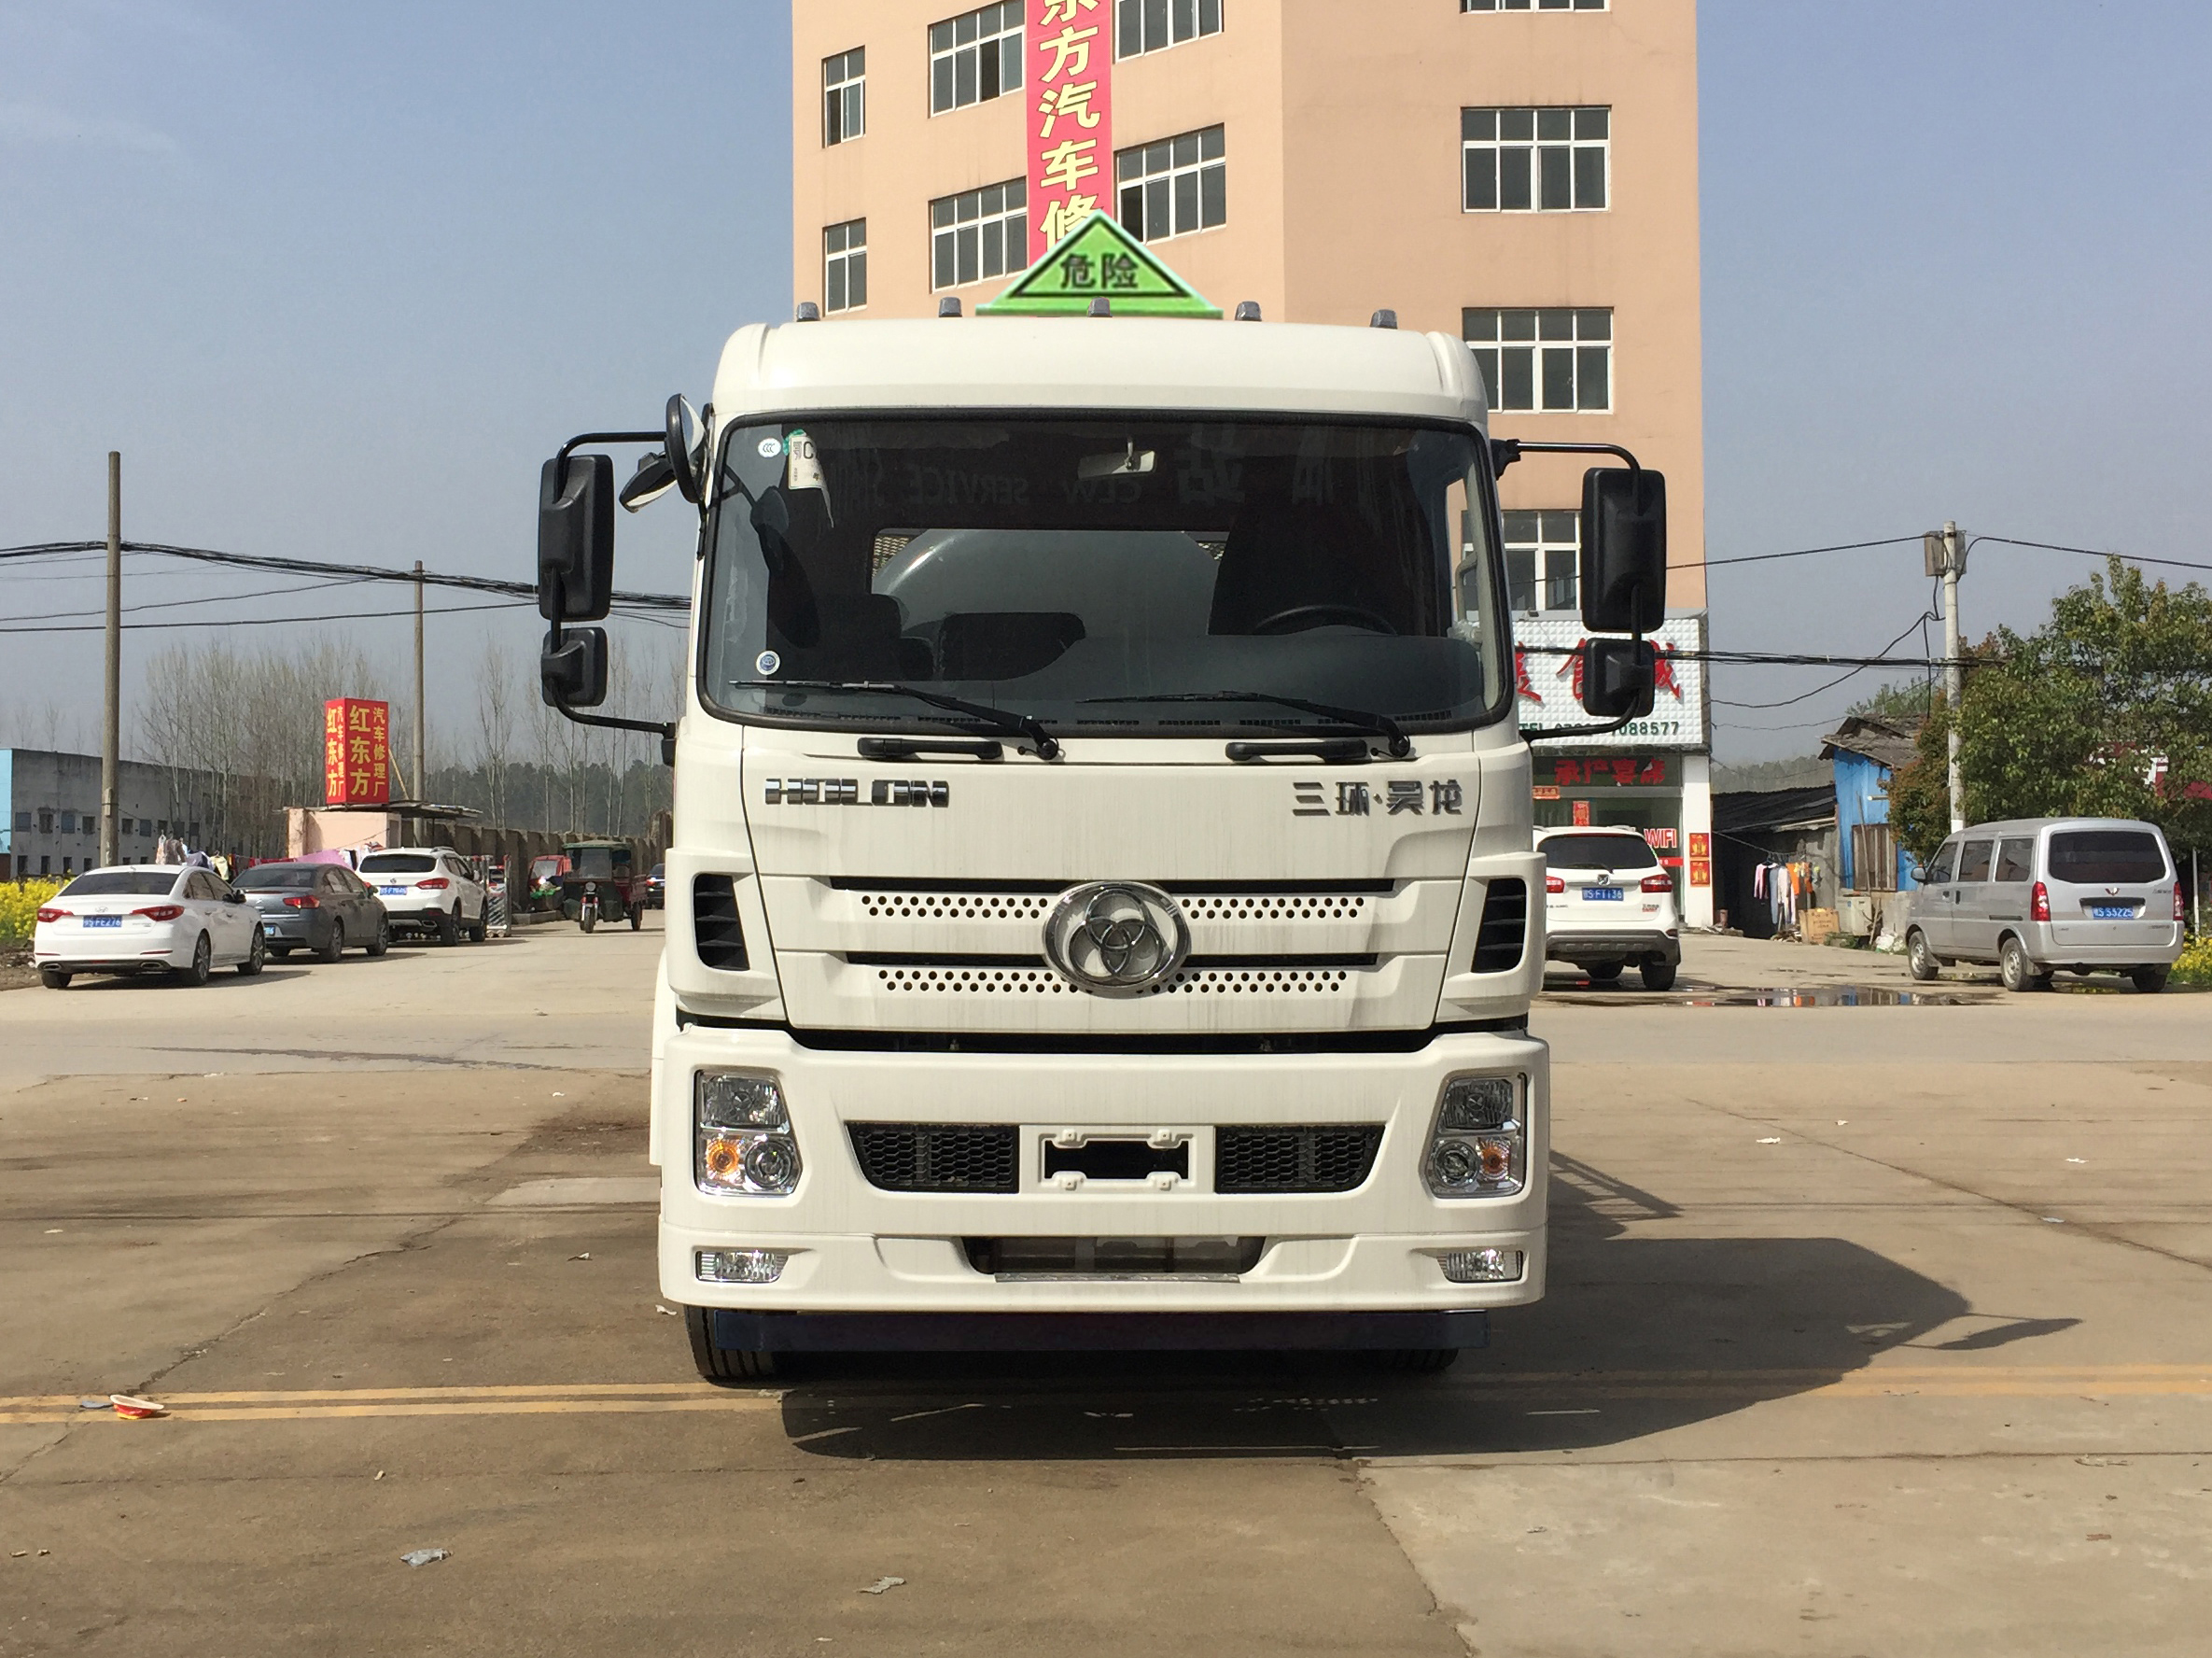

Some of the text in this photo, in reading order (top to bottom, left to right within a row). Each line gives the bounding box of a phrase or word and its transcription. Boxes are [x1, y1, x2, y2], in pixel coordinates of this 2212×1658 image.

[1060, 253, 1139, 289] 危险
[327, 707, 338, 796] 红东方
[349, 705, 371, 796] 红东方
[372, 707, 386, 797] 汽车修理厂
[1644, 828, 1677, 849] WIFI
